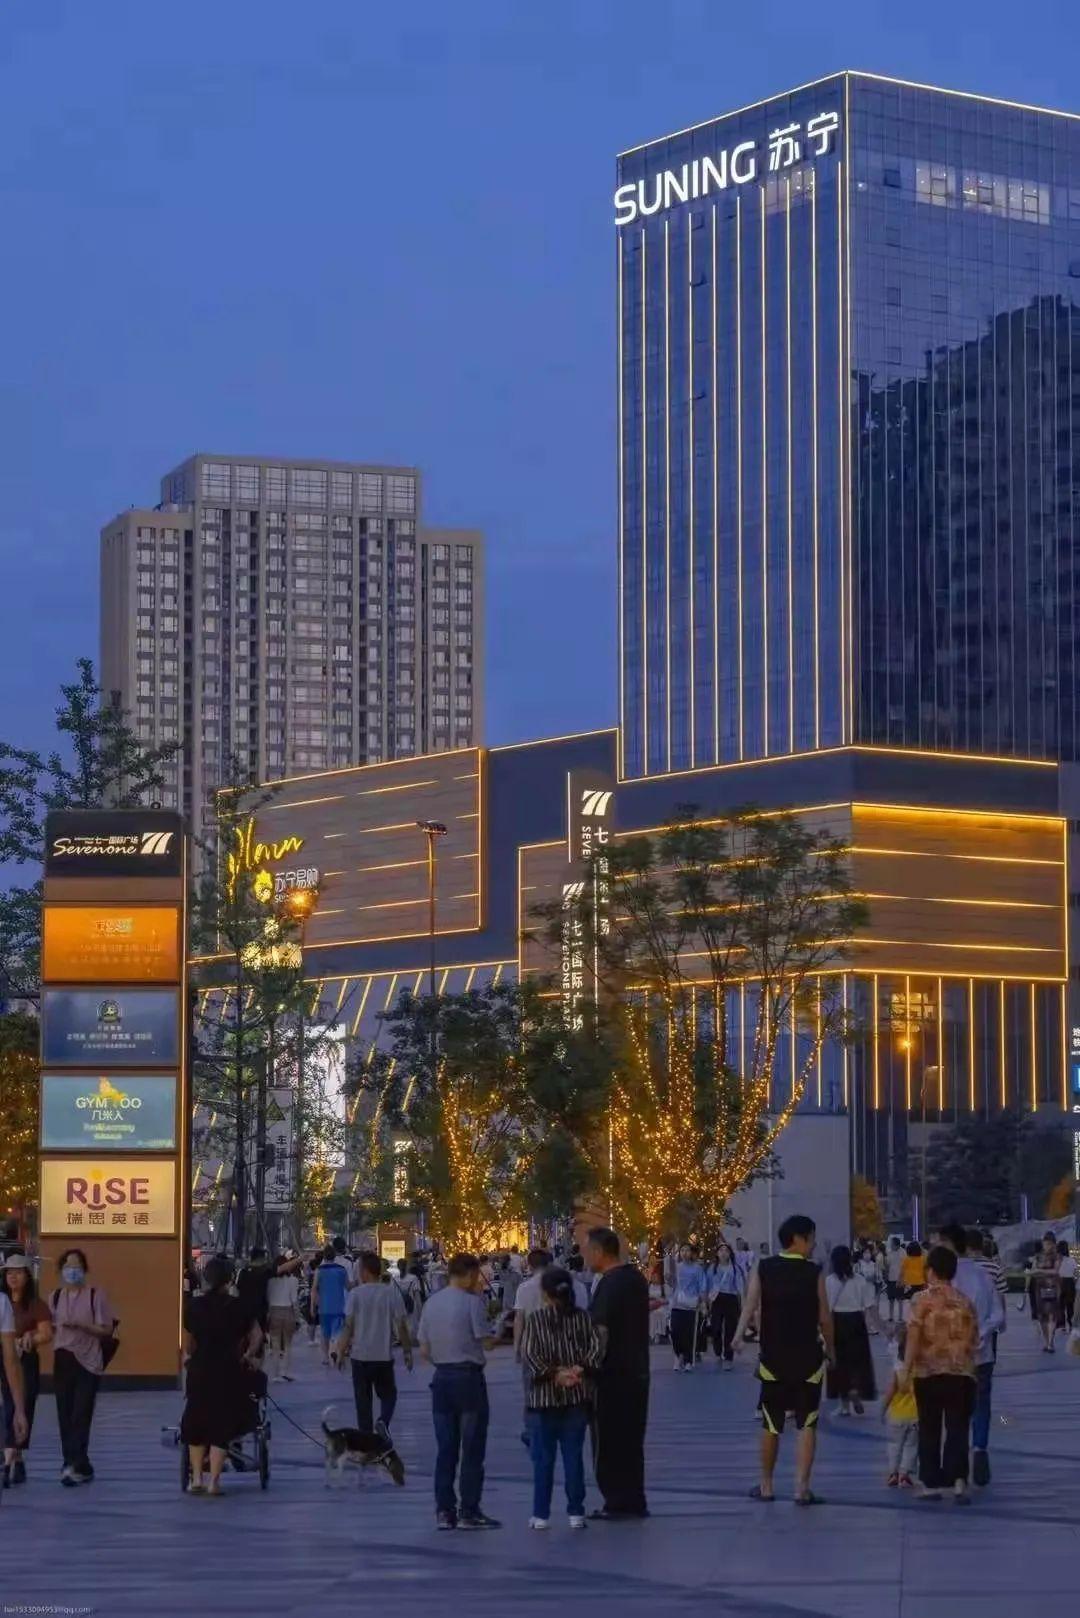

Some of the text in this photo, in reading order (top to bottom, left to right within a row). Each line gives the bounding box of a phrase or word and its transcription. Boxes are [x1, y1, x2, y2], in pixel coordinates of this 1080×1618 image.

[614, 112, 839, 225] SUNING 苏宁
[53, 837, 137, 856] Sevenone
[67, 1212, 150, 1226] 瑞思英语
